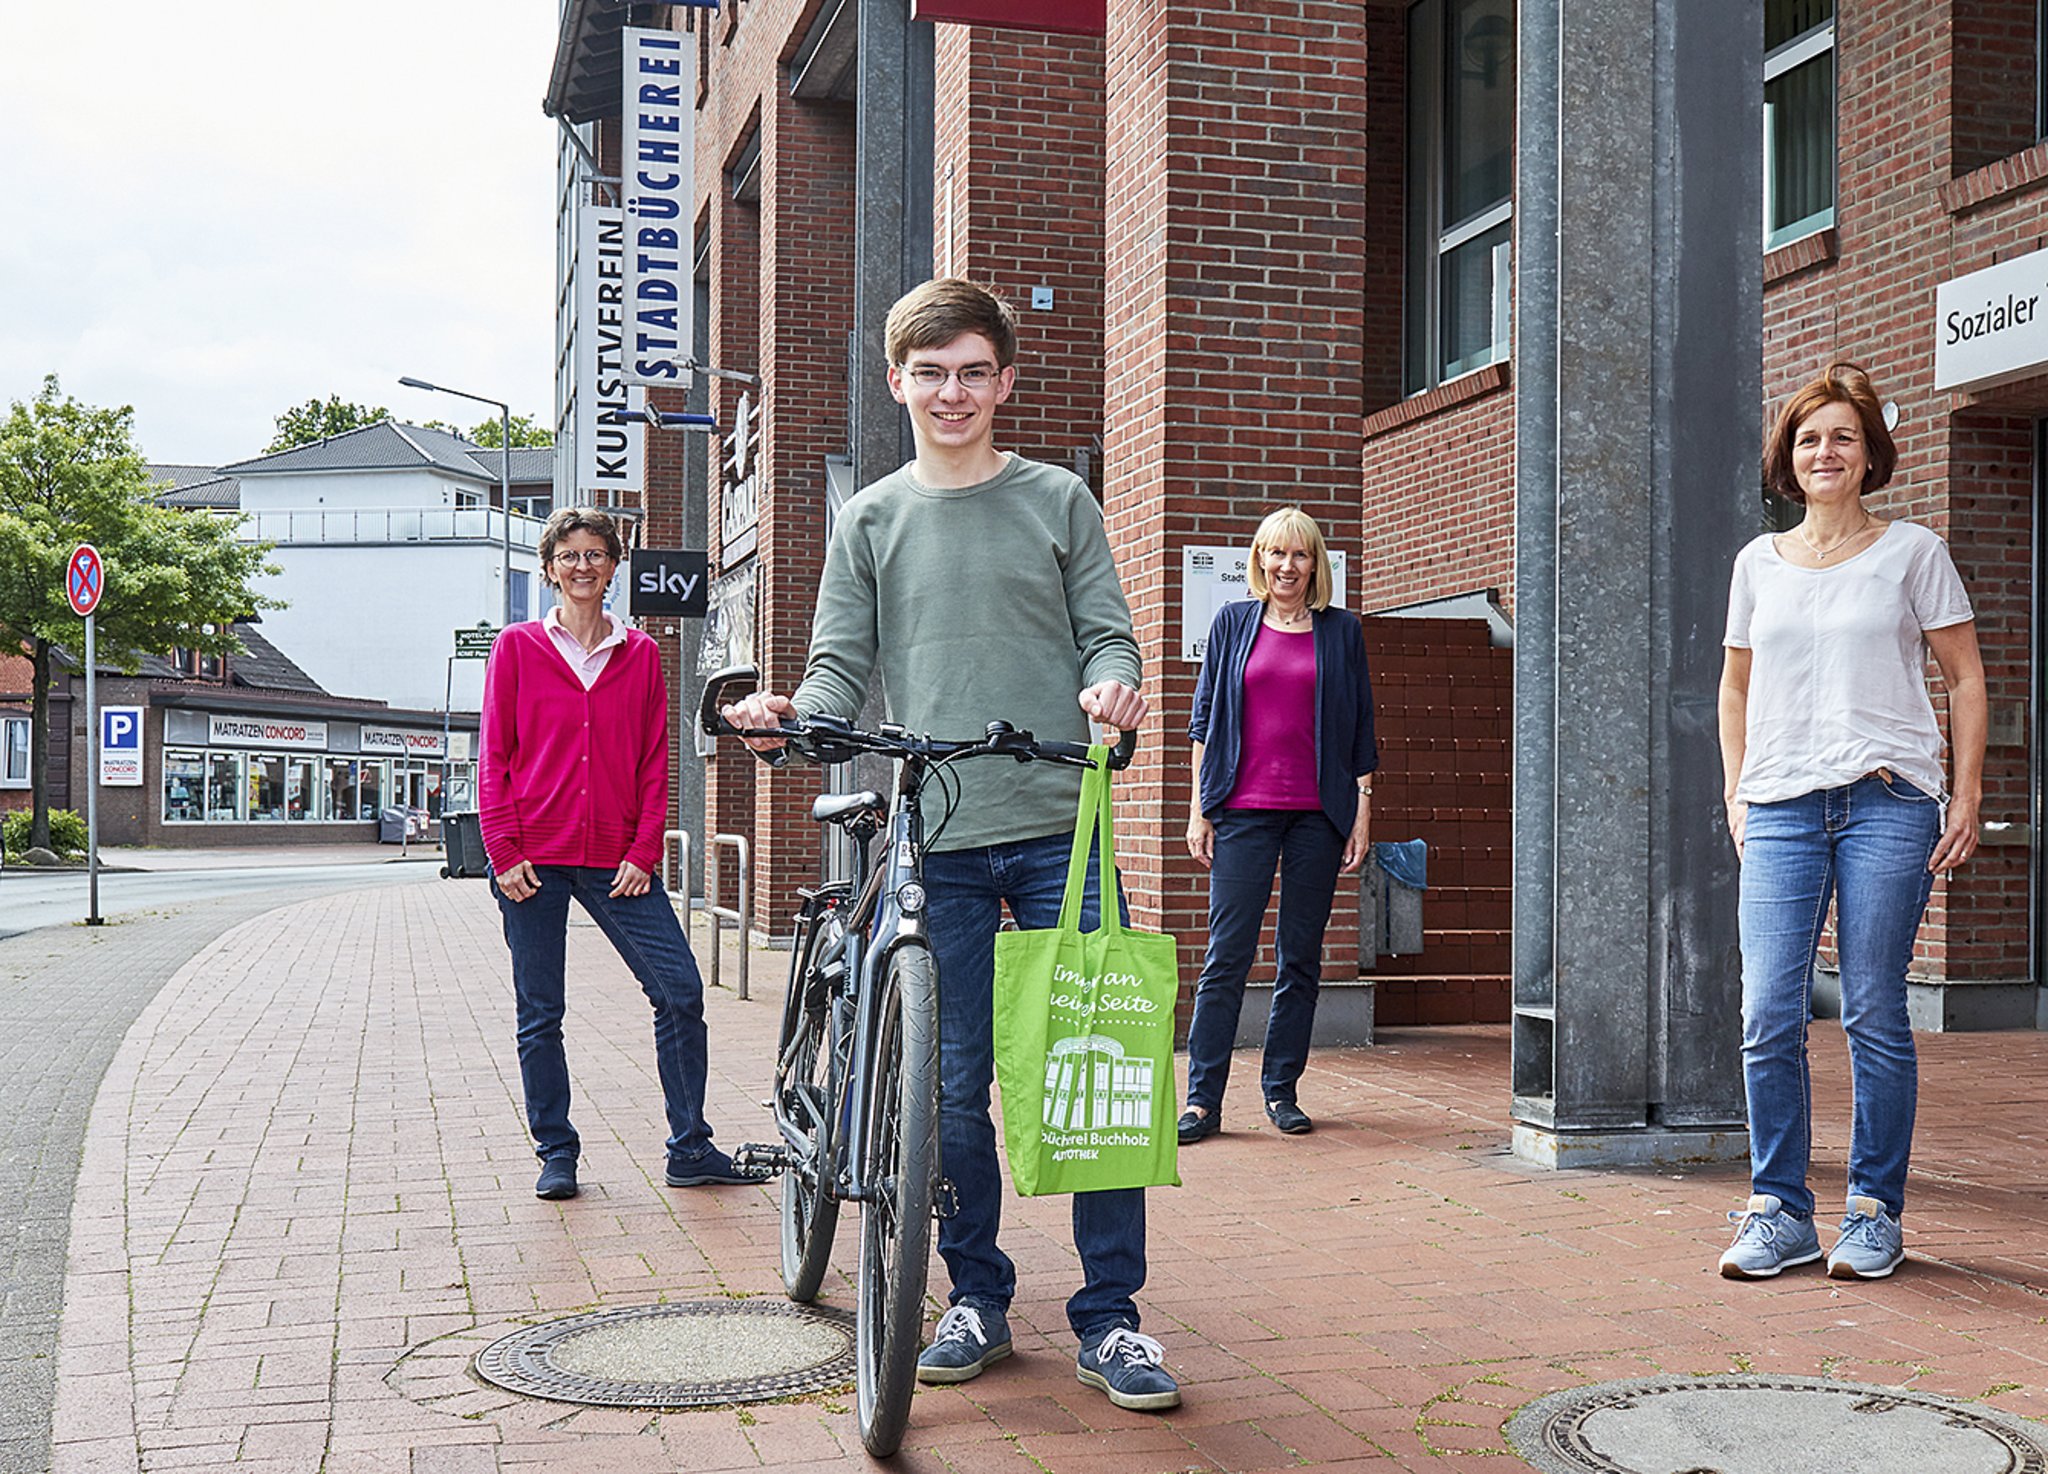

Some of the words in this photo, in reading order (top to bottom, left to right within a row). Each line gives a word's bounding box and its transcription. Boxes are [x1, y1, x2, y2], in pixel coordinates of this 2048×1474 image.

[628, 37, 682, 380] STADTBÜCHEREI
[1946, 293, 2040, 347] Sozialer
[639, 564, 700, 602] sky
[111, 715, 132, 745] P
[213, 721, 264, 738] MATRATZEN
[264, 725, 307, 741] CONCORD
[405, 734, 438, 749] CONCORD
[1103, 971, 1144, 988] an
[1098, 993, 1159, 1014] Seite
[1090, 1131, 1150, 1147] Buchholz
